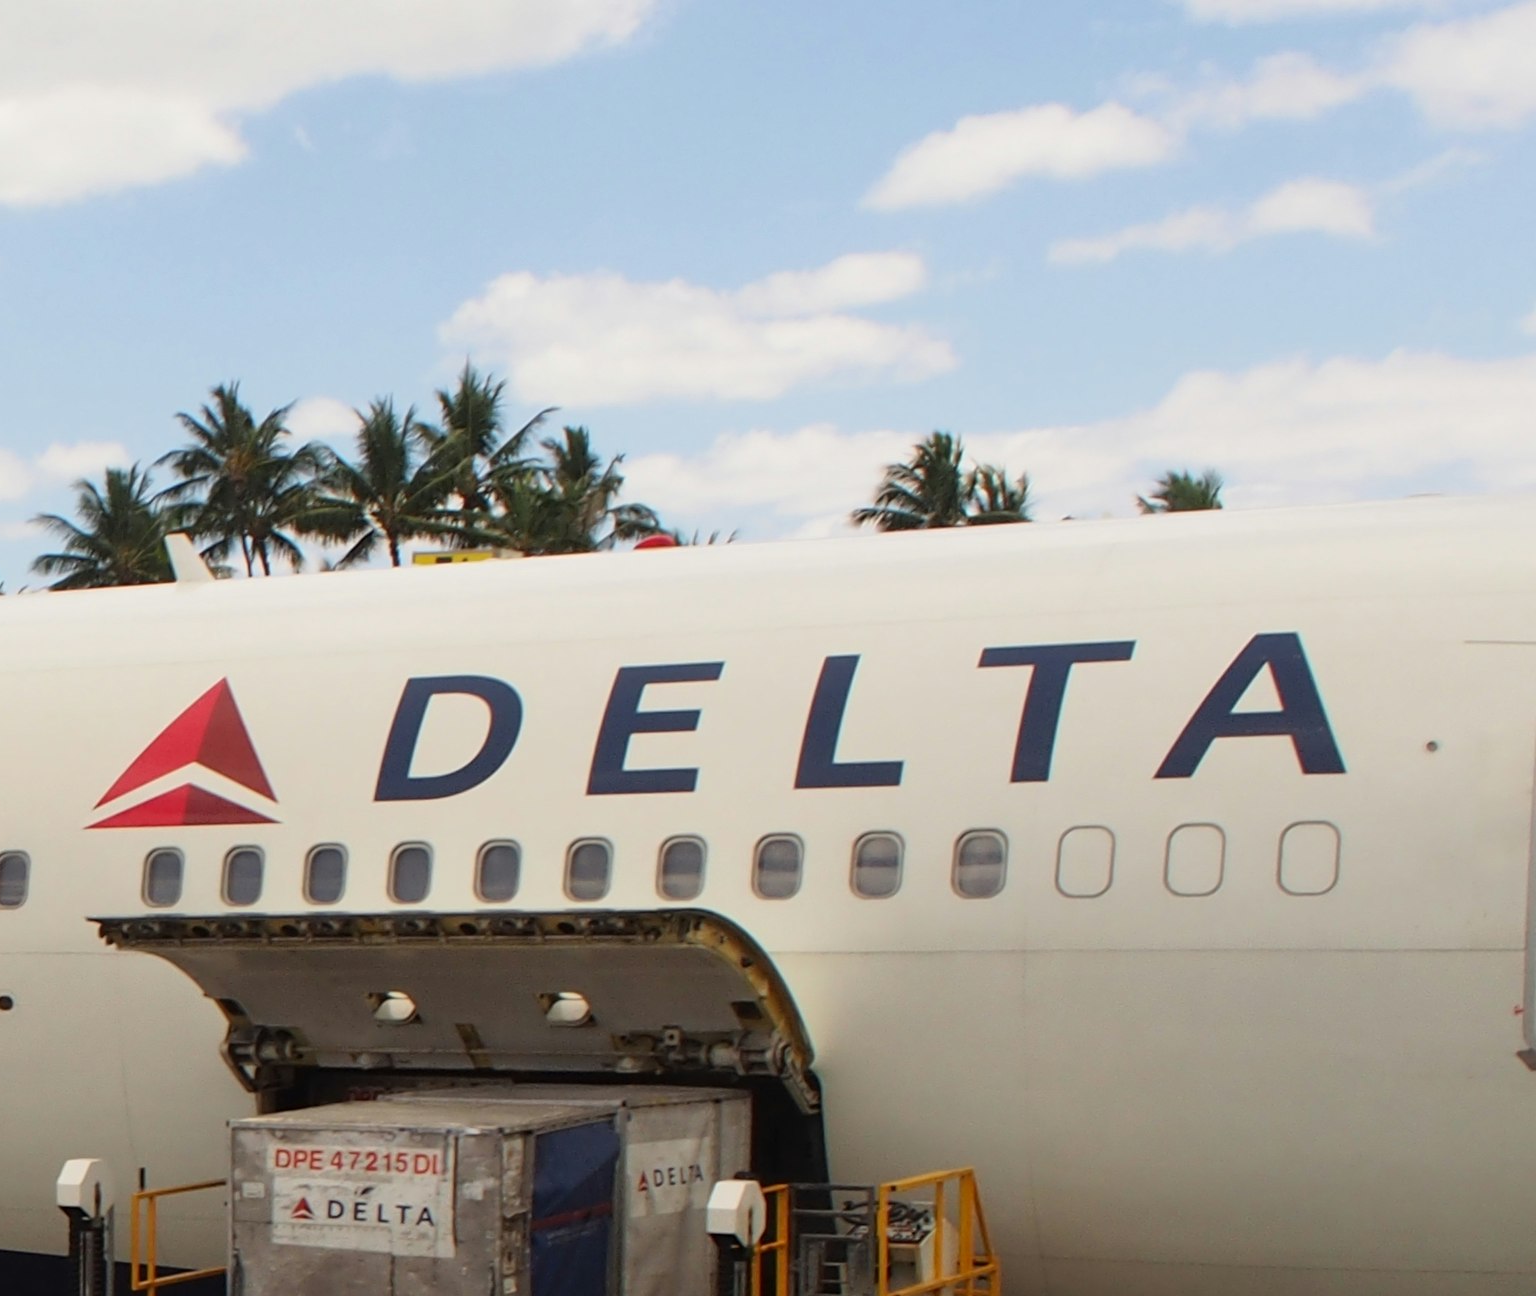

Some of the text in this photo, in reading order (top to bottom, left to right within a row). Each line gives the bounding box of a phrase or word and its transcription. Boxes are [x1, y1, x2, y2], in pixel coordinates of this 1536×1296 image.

[373, 631, 1347, 802] DELTA
[653, 1164, 704, 1187] DELTA
[328, 1199, 435, 1227] DELTA
